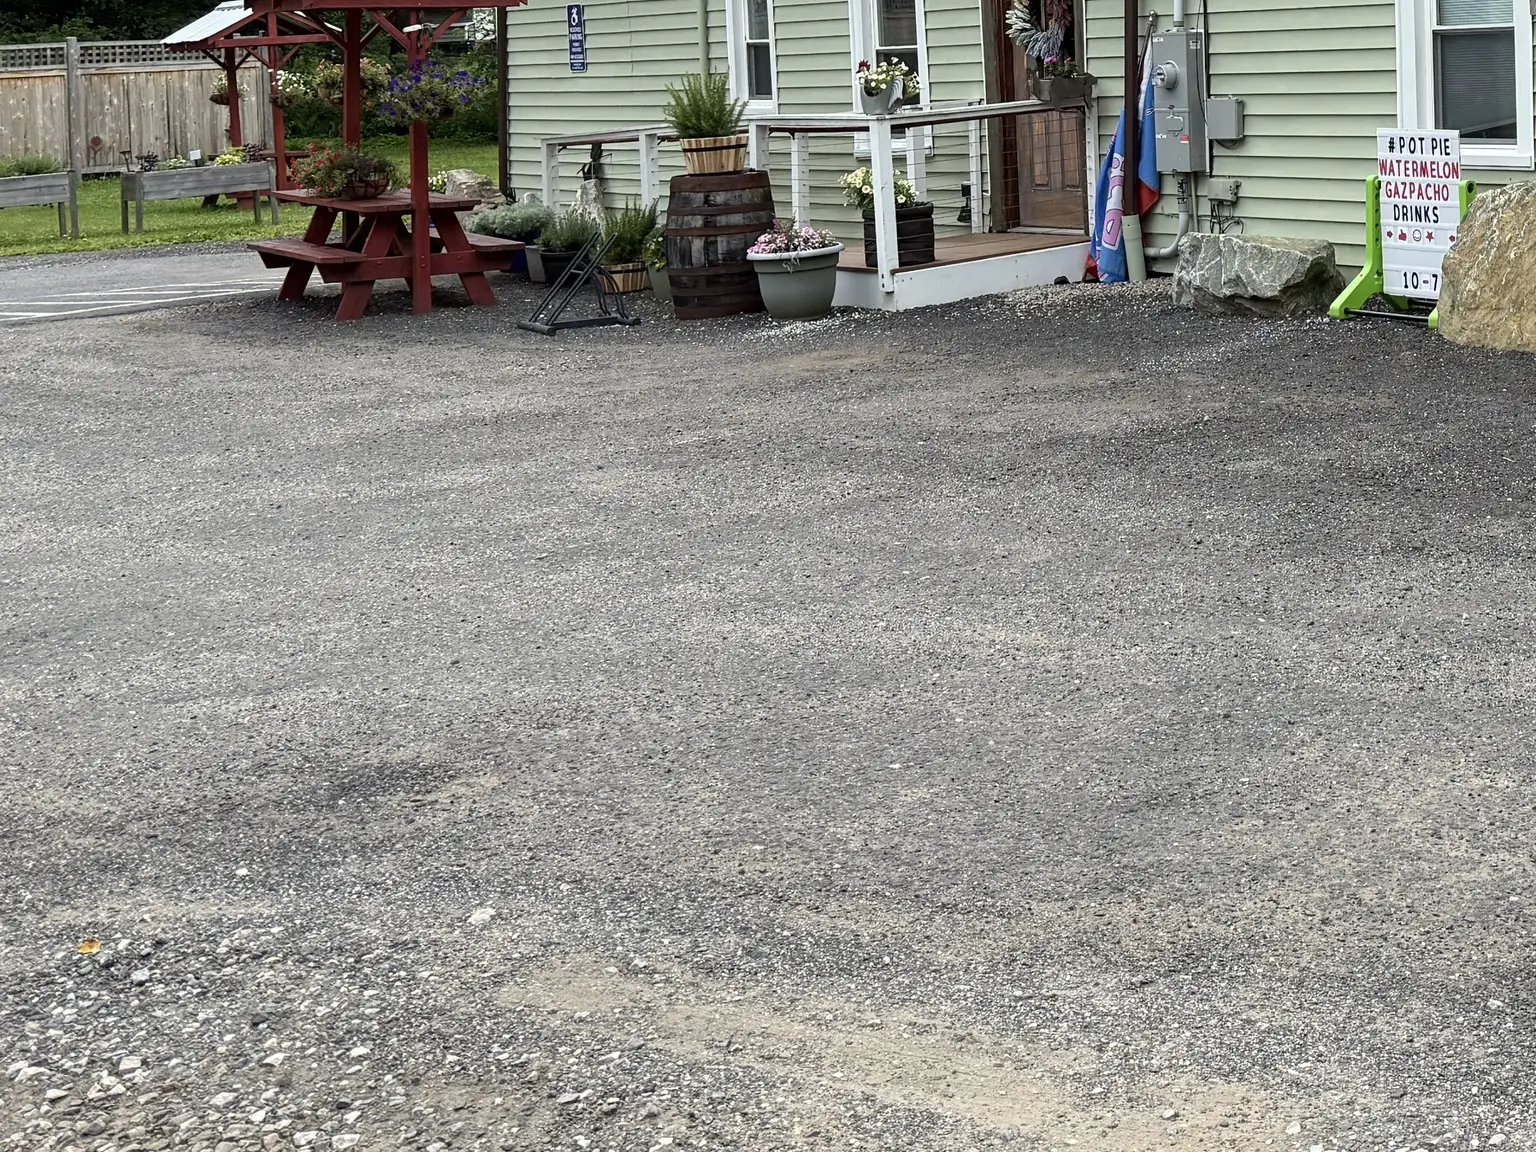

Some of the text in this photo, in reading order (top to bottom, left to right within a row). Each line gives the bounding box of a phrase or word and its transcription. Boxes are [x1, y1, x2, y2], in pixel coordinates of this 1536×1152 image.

[1388, 136, 1451, 156] #POT PIE
[1379, 158, 1460, 180] WATERMELON
[1385, 181, 1450, 202] GAZPACHO
[1393, 204, 1439, 224] DRINKS
[1402, 271, 1439, 291] 10-7
